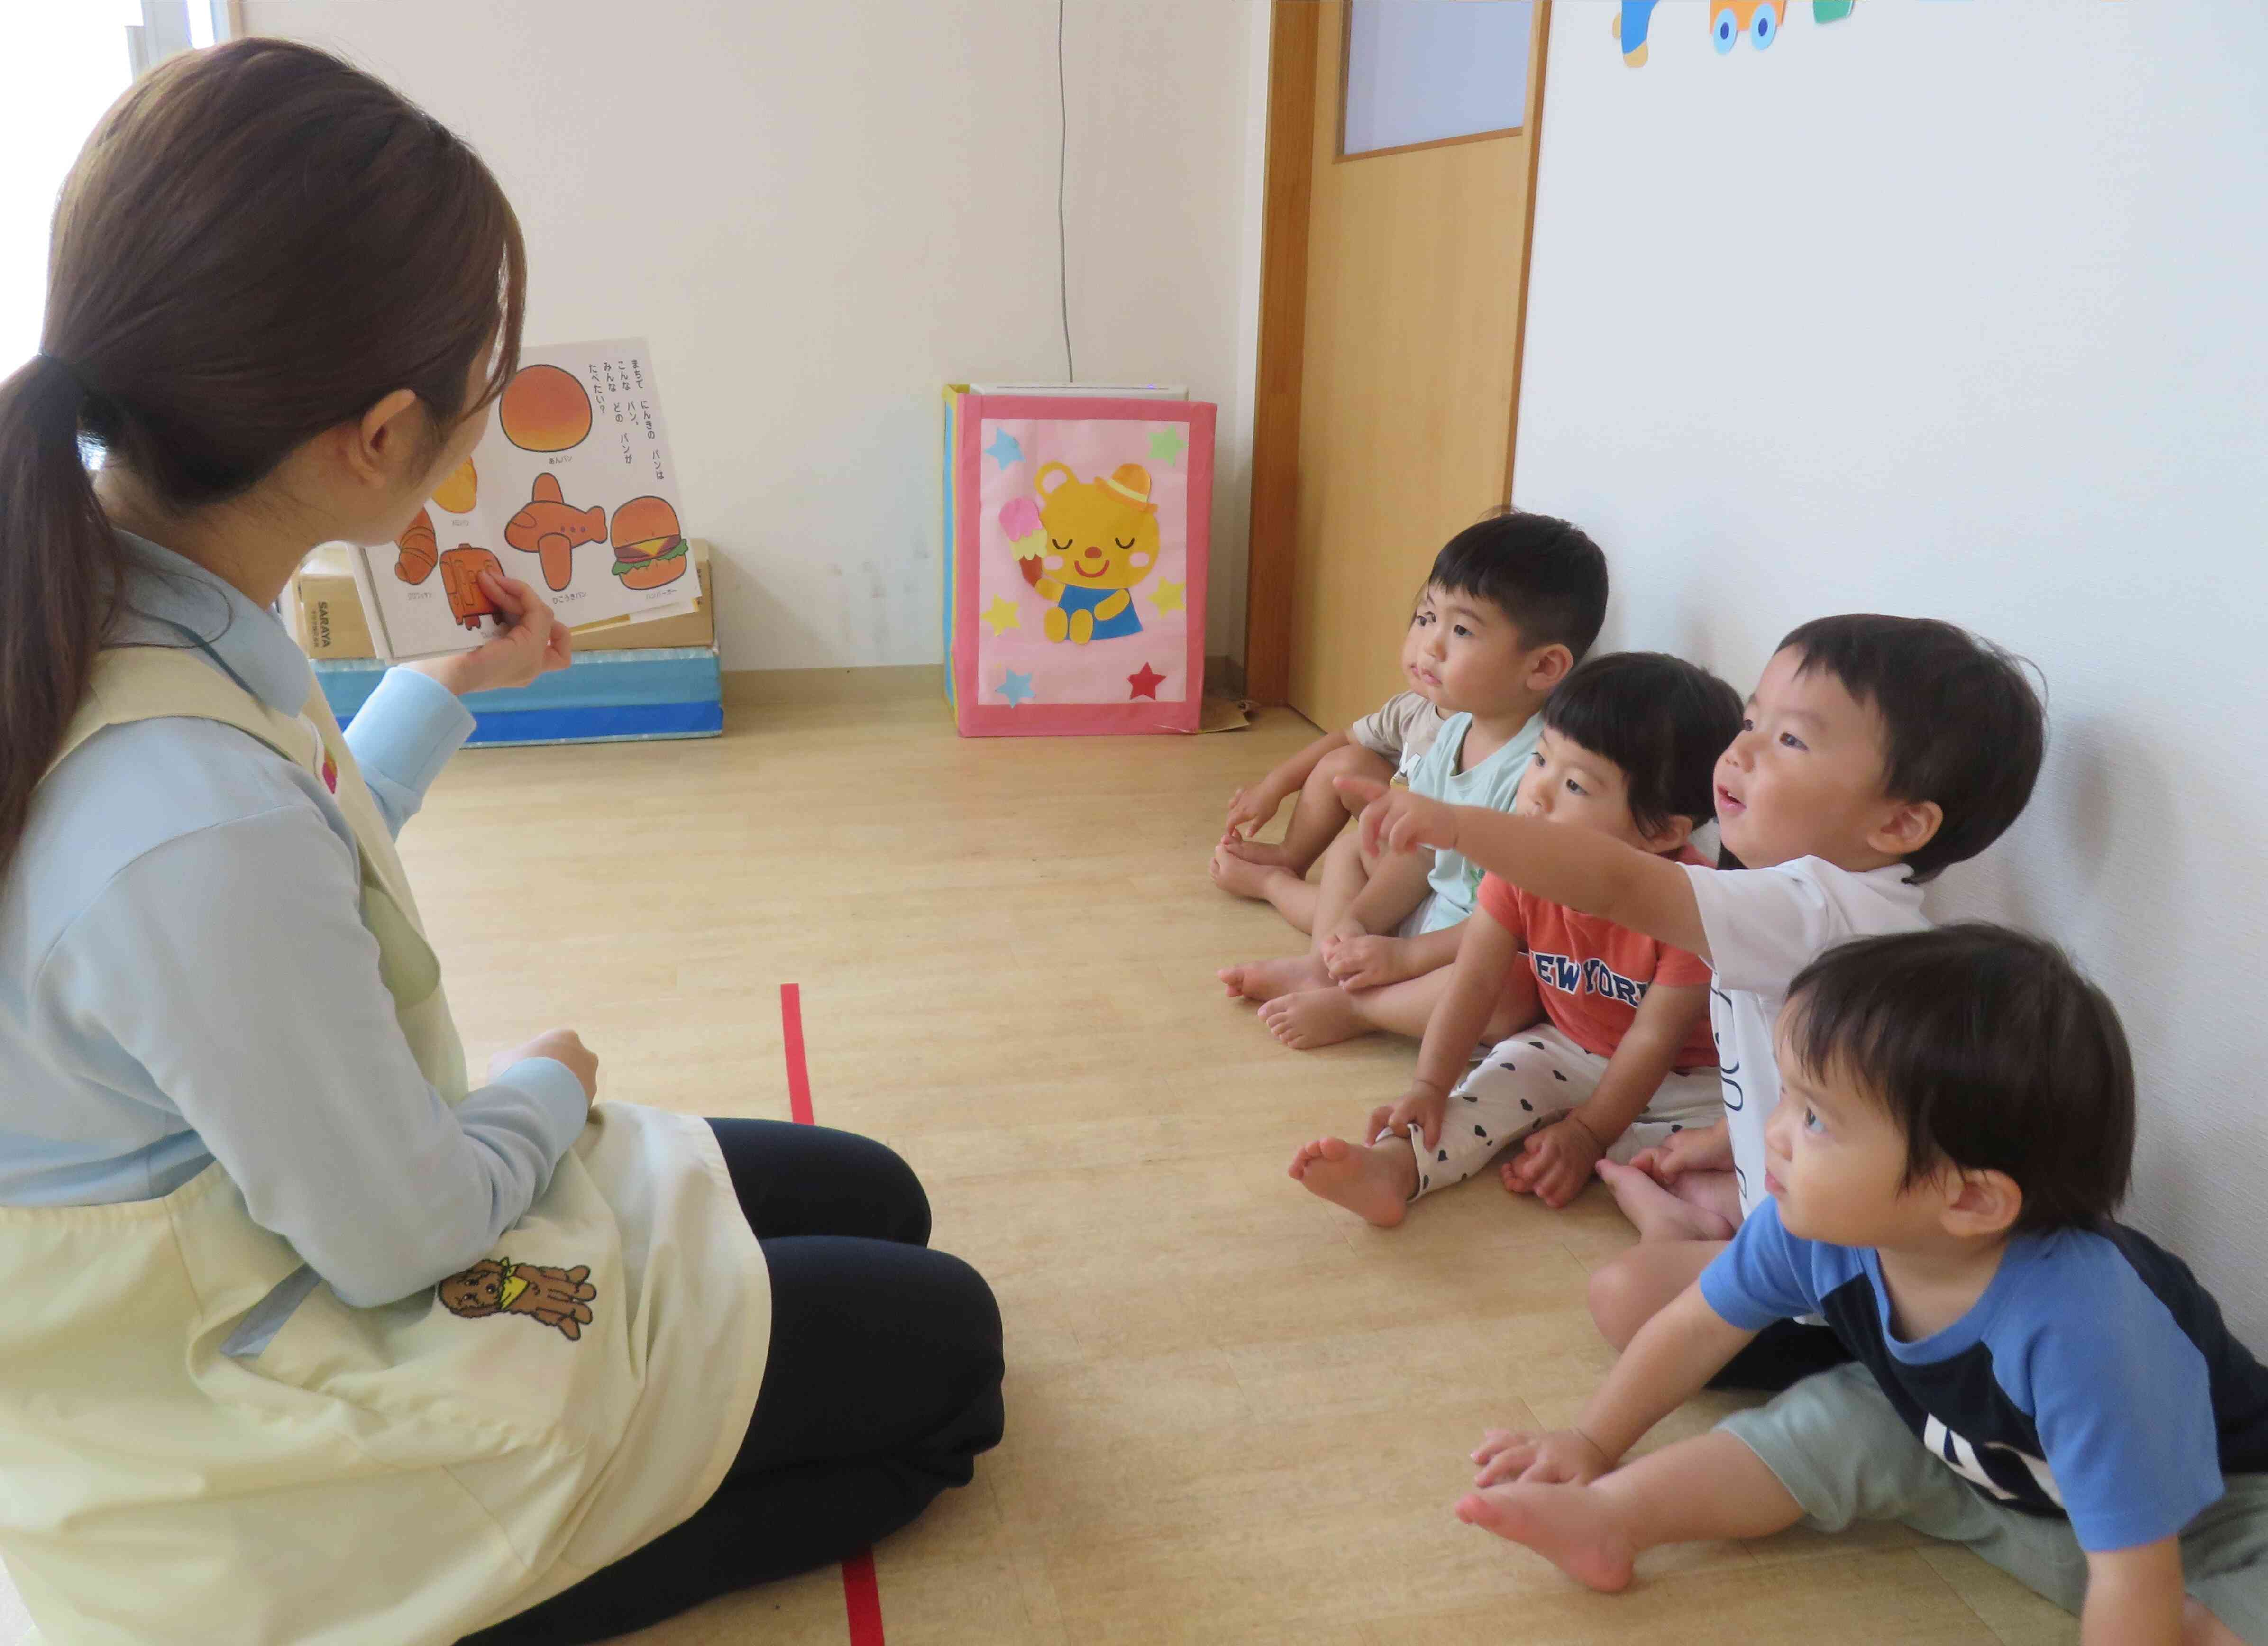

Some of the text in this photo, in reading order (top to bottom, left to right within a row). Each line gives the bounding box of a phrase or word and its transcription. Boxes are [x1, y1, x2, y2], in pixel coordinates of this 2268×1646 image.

[604, 362, 616, 392] みんな
[618, 361, 631, 391] こんな
[641, 401, 655, 439] にんきの
[318, 601, 331, 648] SARAYA
[1530, 950, 1582, 995] EW
